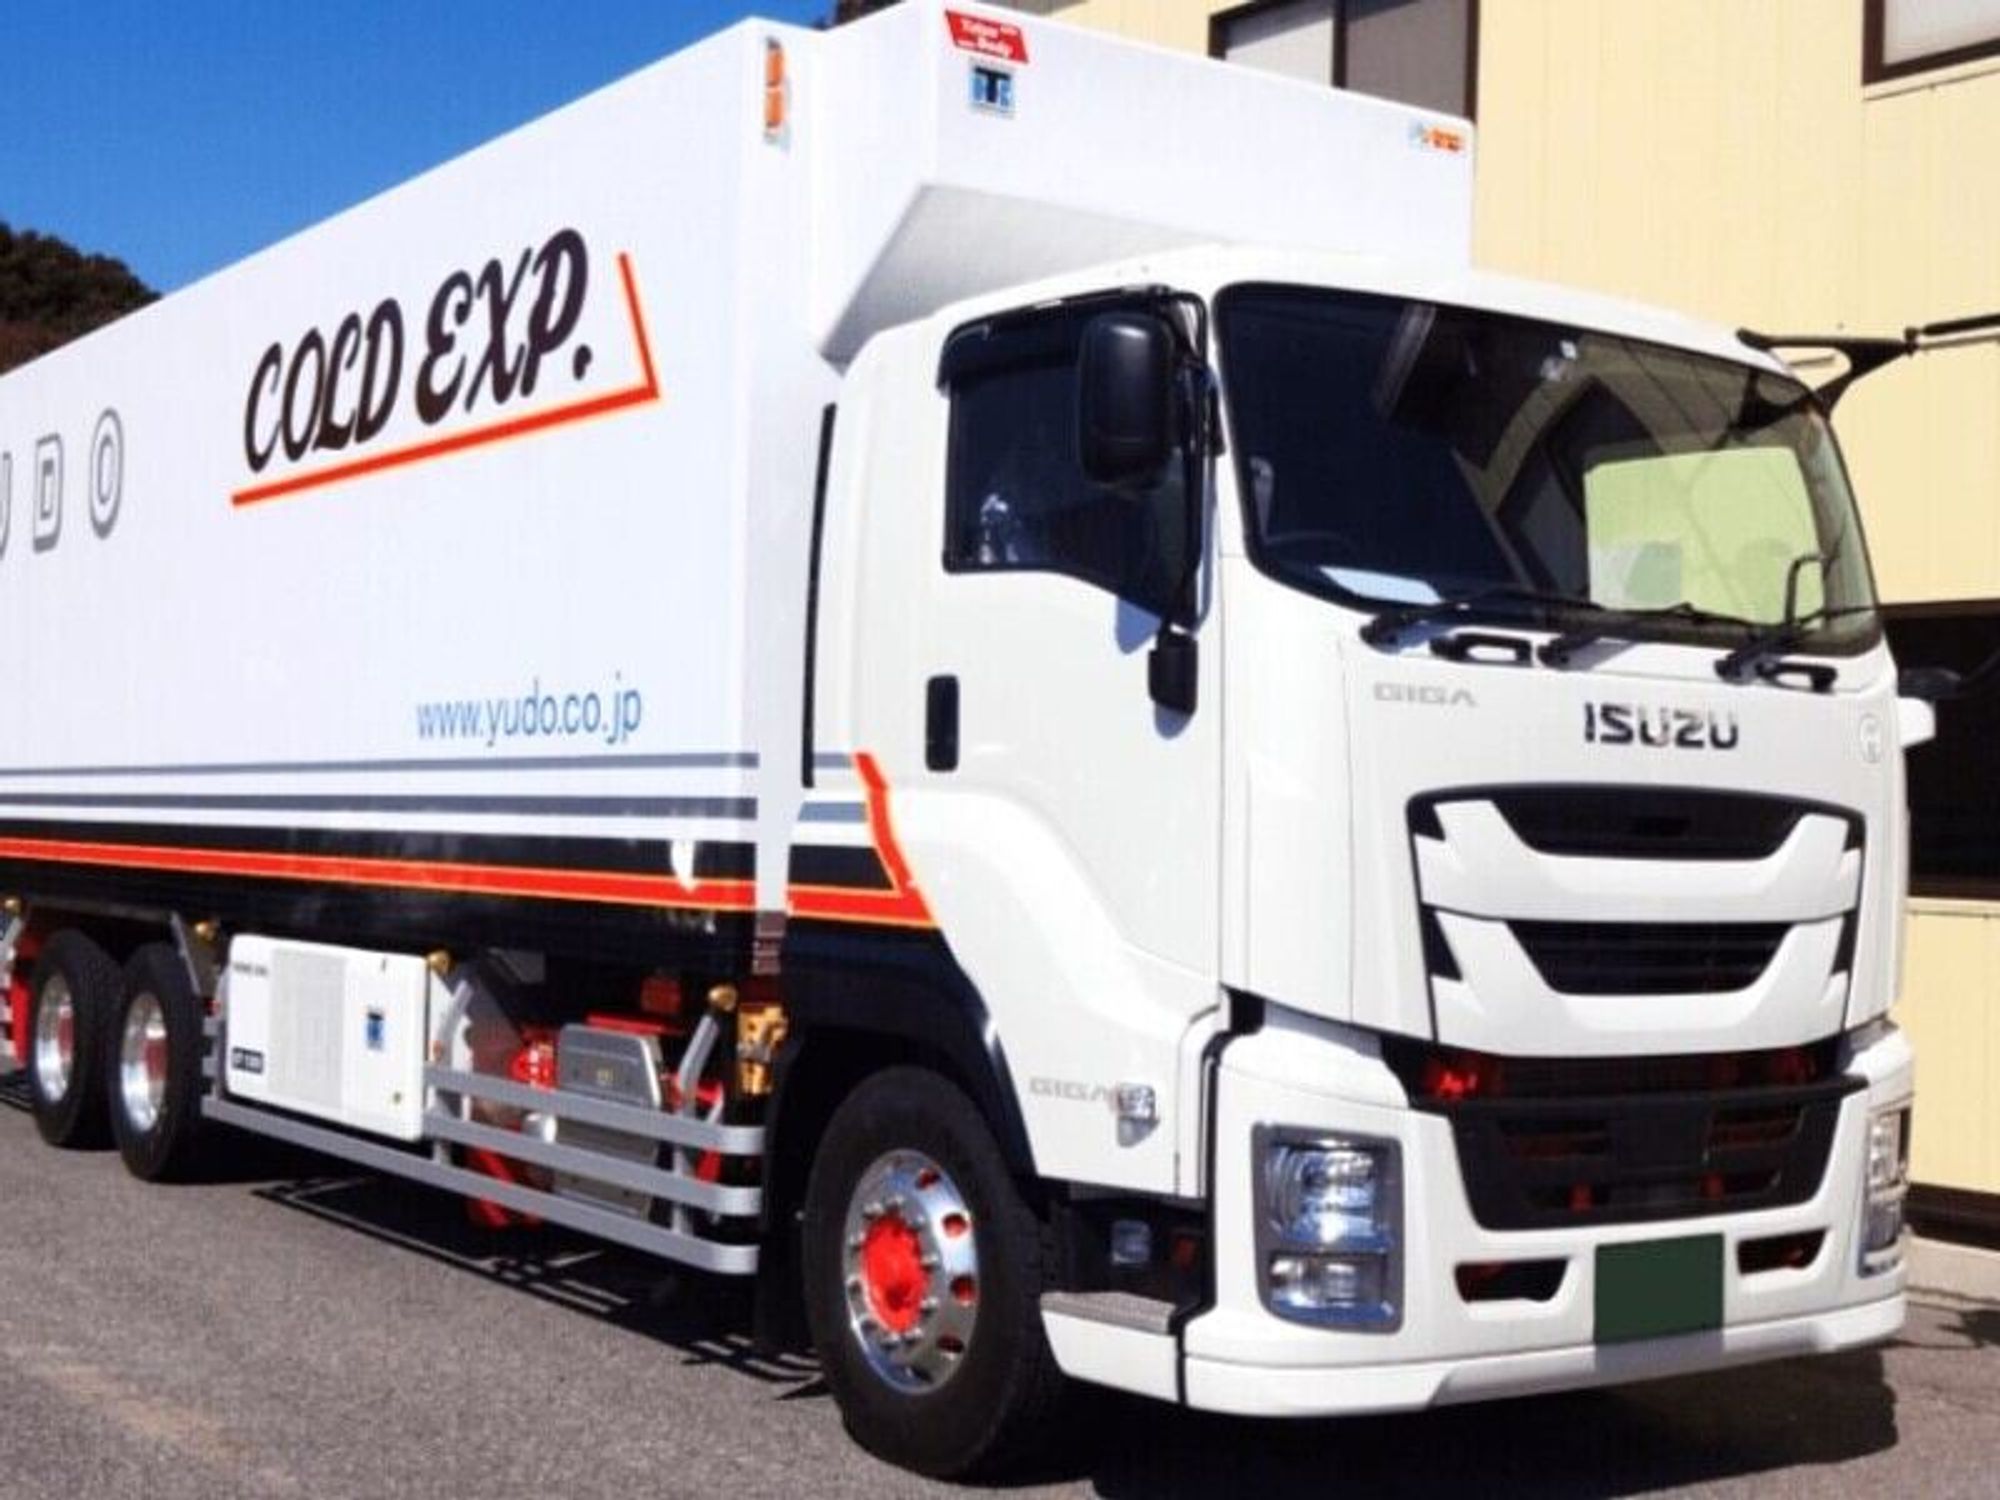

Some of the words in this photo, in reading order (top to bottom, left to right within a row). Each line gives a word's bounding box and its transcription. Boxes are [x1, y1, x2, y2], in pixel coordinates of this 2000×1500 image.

[245, 296, 404, 473] COLD
[415, 228, 592, 425] EXP.
[416, 669, 642, 749] www.yudo.co.jp
[1374, 681, 1478, 708] GIGA
[1584, 701, 1739, 750] ISUZU
